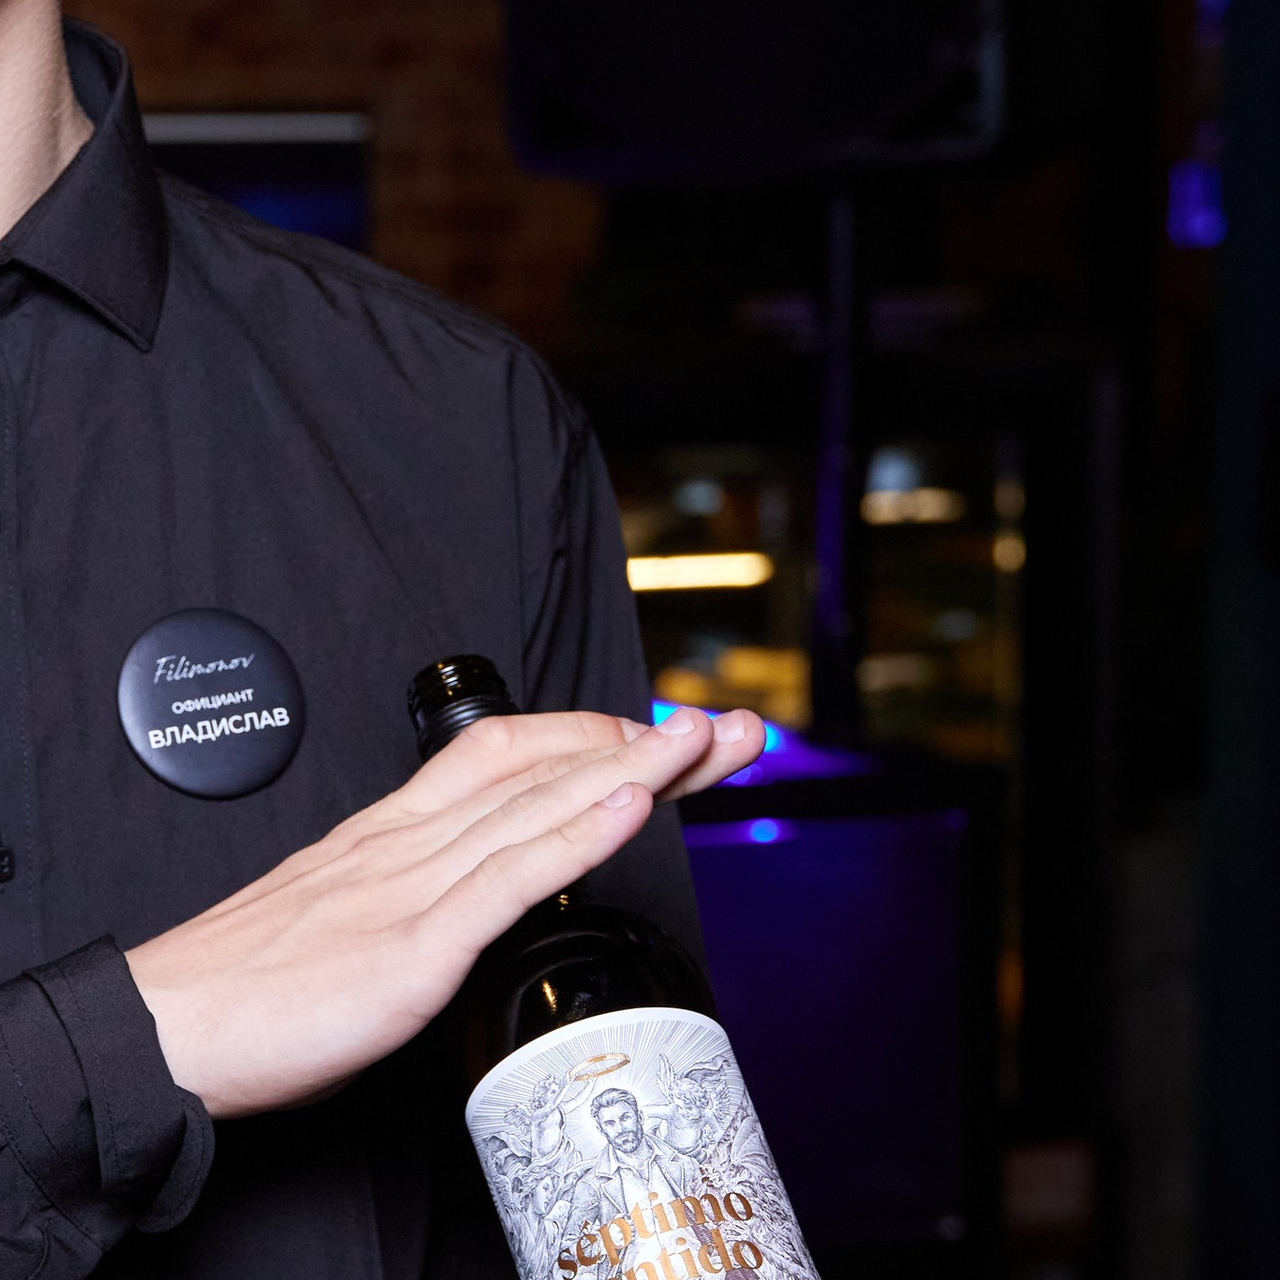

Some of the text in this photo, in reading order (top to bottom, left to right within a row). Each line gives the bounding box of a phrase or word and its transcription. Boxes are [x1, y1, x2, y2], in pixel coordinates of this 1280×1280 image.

[153, 652, 255, 684] Filimonov
[171, 688, 254, 715] ОФИЦИАНТ
[148, 707, 290, 749] ВЛАДИСЛАВ
